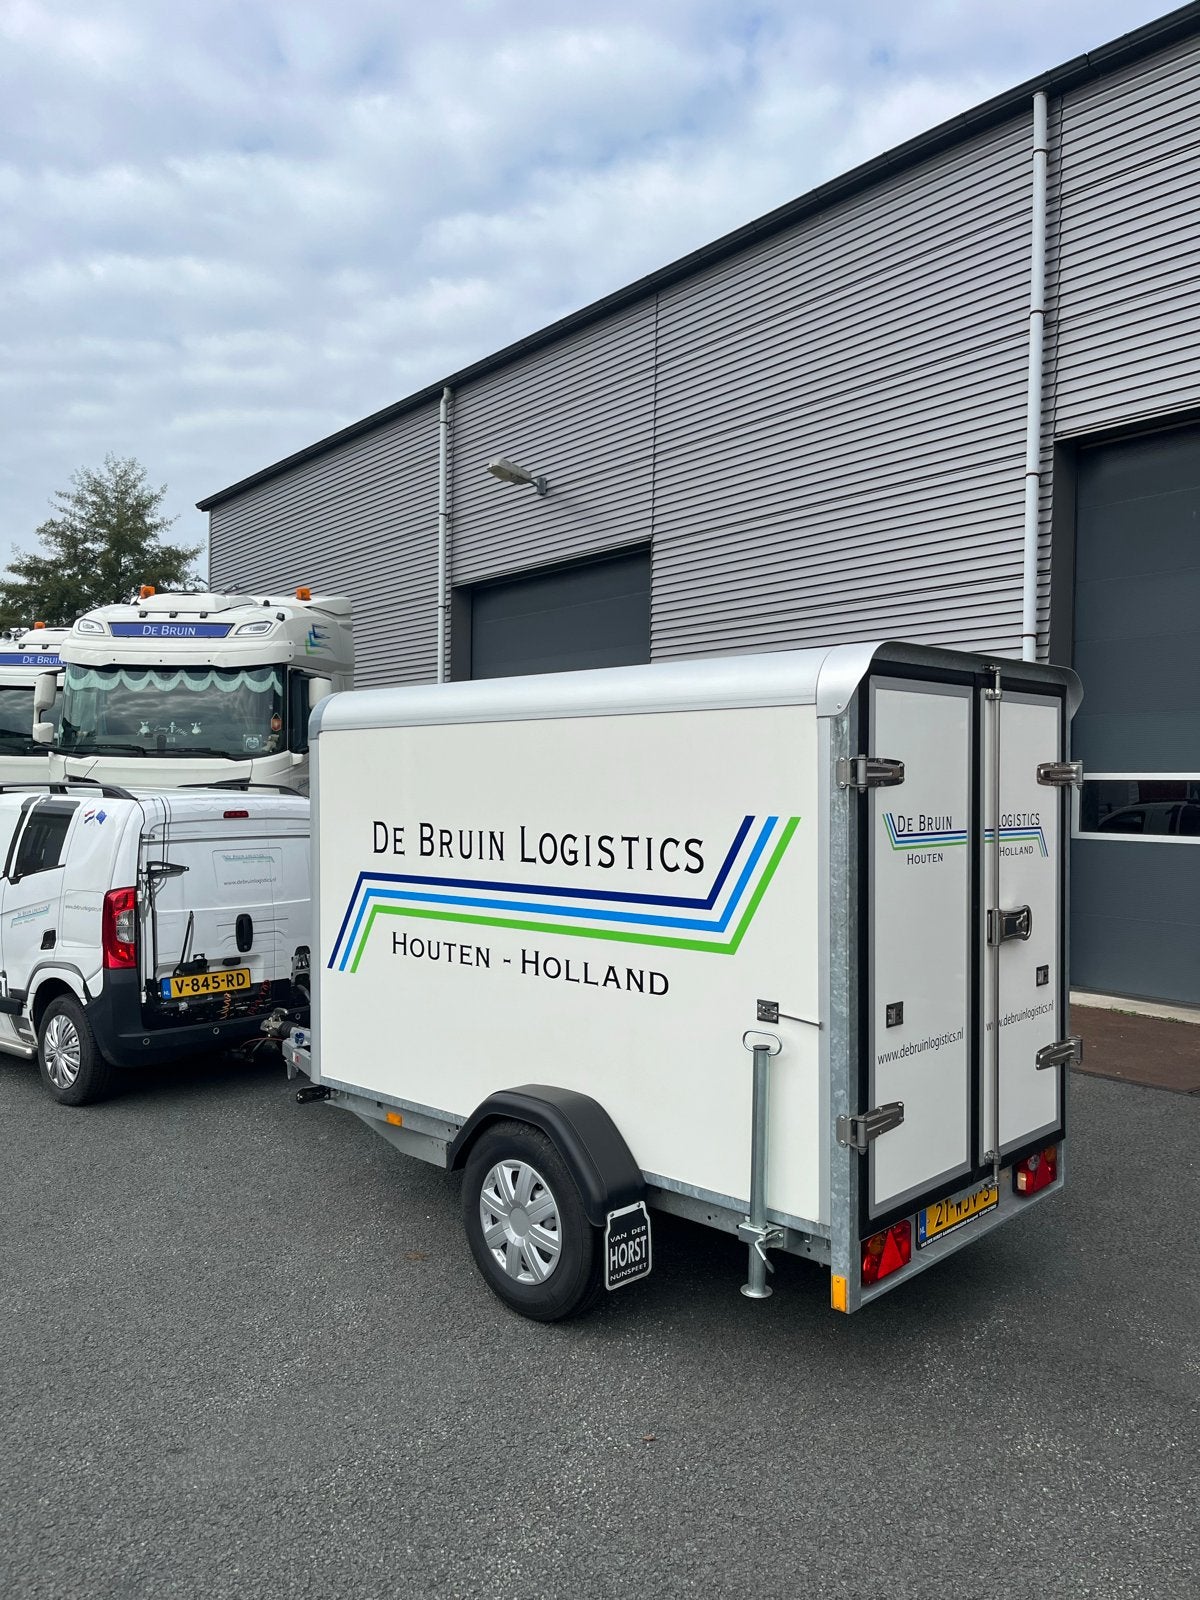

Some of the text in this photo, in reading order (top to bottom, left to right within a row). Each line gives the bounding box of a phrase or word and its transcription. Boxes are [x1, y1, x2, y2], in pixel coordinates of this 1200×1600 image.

[142, 625, 196, 636] DE BRUIN
[22, 655, 35, 664] DE
[897, 812, 1041, 832] DE BRUIN OGISTICS
[372, 820, 705, 874] DE BRUIN LOGISTICS
[906, 845, 1034, 865] HOUTEN HOLLAND
[391, 931, 491, 969] HOUTEN
[520, 949, 669, 996] HOLLAND
[175, 973, 245, 994] V-845-RD
[985, 1000, 1054, 1032] ww.debruinlogistics.nl
[877, 1027, 964, 1065] www.debruinlogistics.nl
[610, 1225, 646, 1243] VAN DER
[610, 1236, 647, 1271] HORST
[610, 1262, 647, 1281] NUNSPEET
